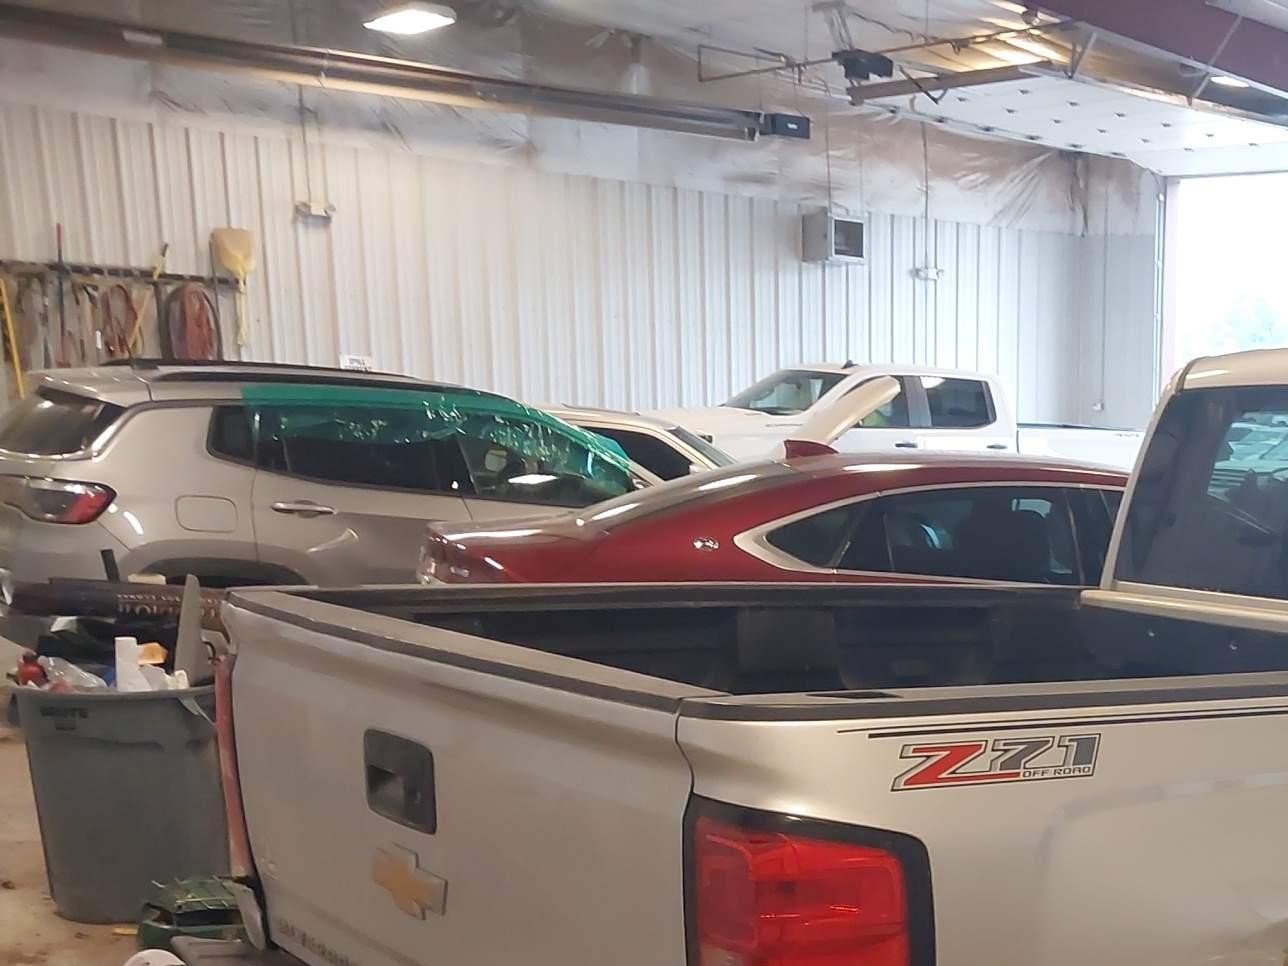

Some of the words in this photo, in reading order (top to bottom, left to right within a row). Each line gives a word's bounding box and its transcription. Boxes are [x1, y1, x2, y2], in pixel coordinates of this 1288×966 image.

[891, 733, 1101, 791] Z71
[1022, 769, 1050, 778] OFF
[1053, 766, 1091, 776] ROAD
